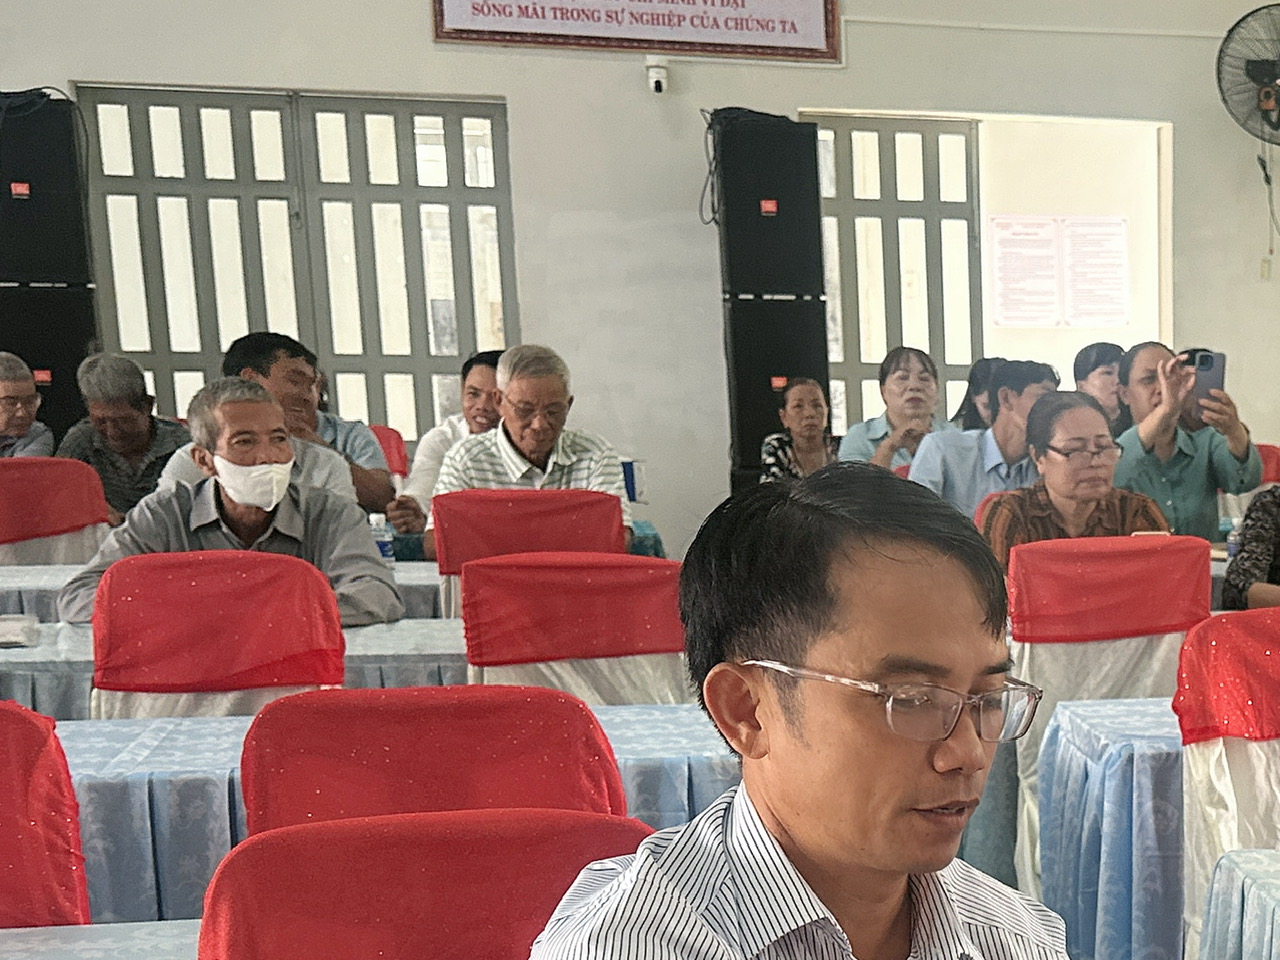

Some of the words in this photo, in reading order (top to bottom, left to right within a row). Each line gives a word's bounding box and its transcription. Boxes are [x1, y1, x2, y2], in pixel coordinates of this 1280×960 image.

[472, 1, 513, 18] SỐNG
[517, 3, 546, 20] MÃI
[551, 7, 601, 23] TRONG
[605, 8, 625, 27] SỰ
[629, 11, 686, 30] NGHIỆP
[689, 11, 720, 30] CỦA
[724, 14, 776, 33] CHÚNG
[780, 20, 798, 34] TA
